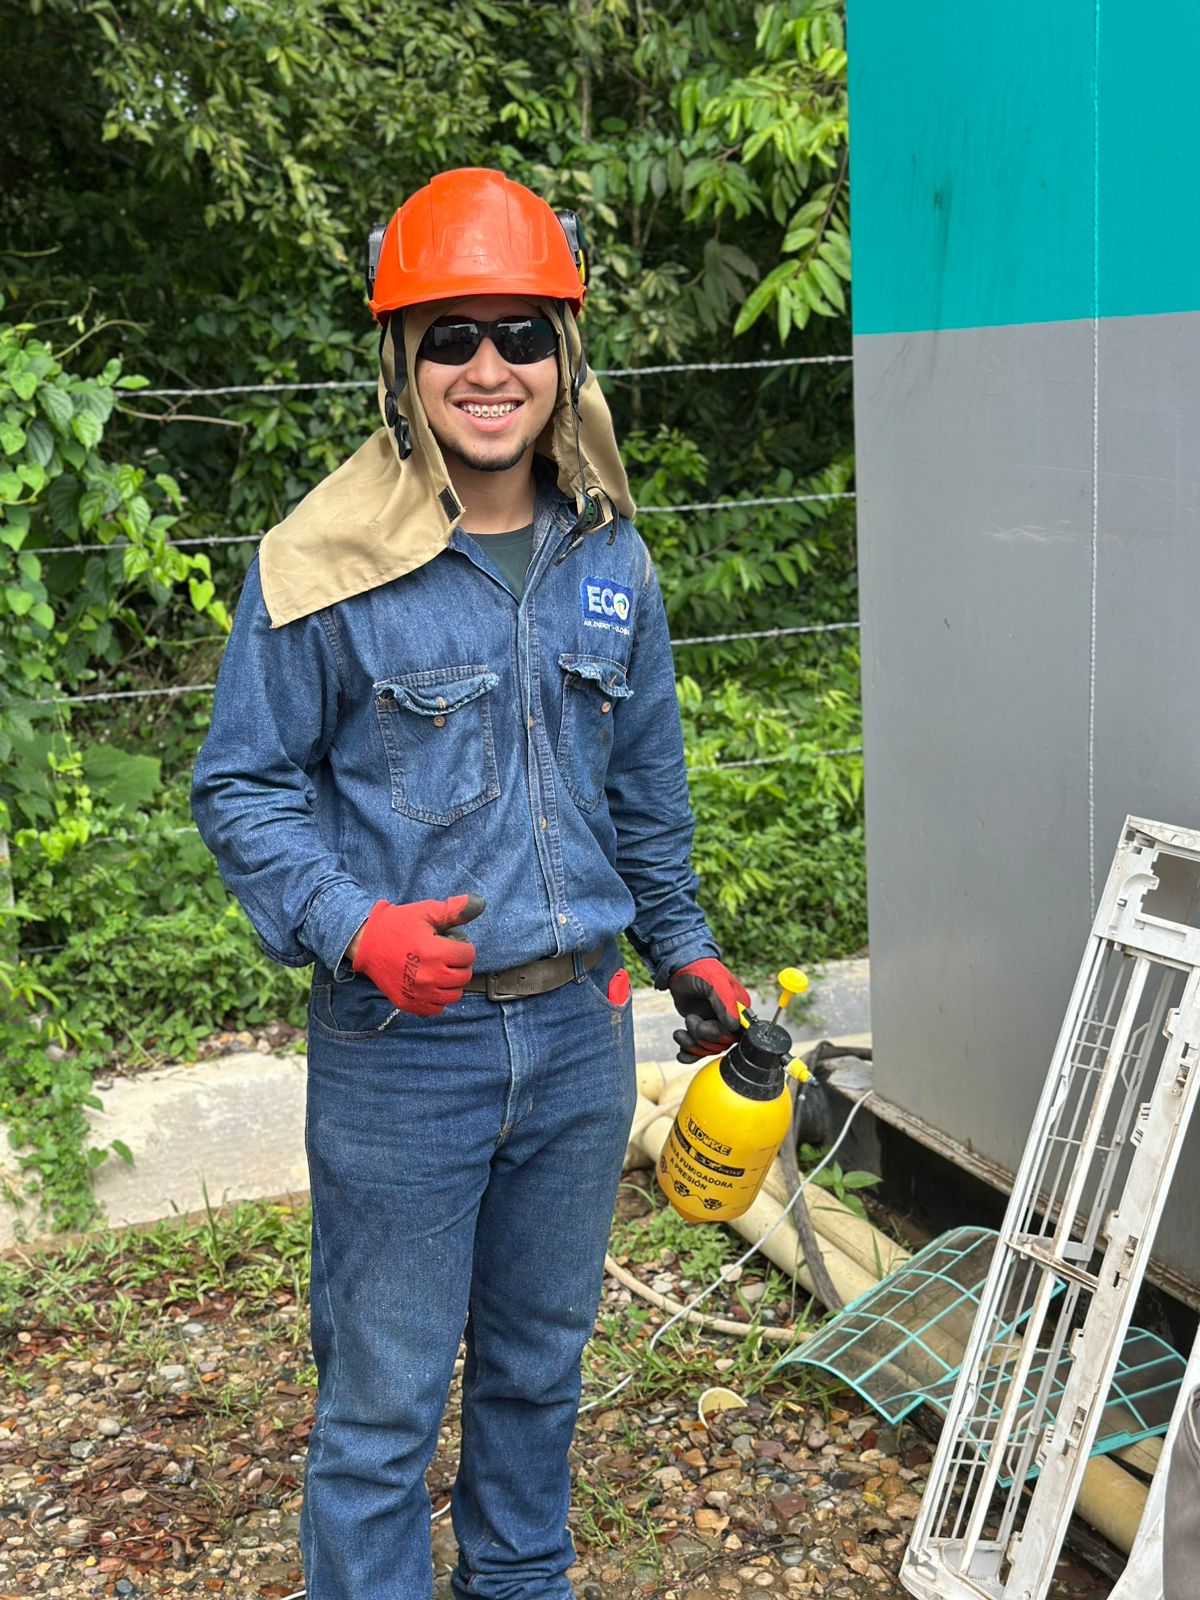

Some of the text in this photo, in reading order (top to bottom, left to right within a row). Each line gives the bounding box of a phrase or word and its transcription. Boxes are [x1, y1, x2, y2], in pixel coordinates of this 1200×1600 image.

[587, 585, 630, 620] ECO
[674, 1163, 708, 1190] PRESIÓN
[680, 1157, 733, 1188] FUMIGADORA
